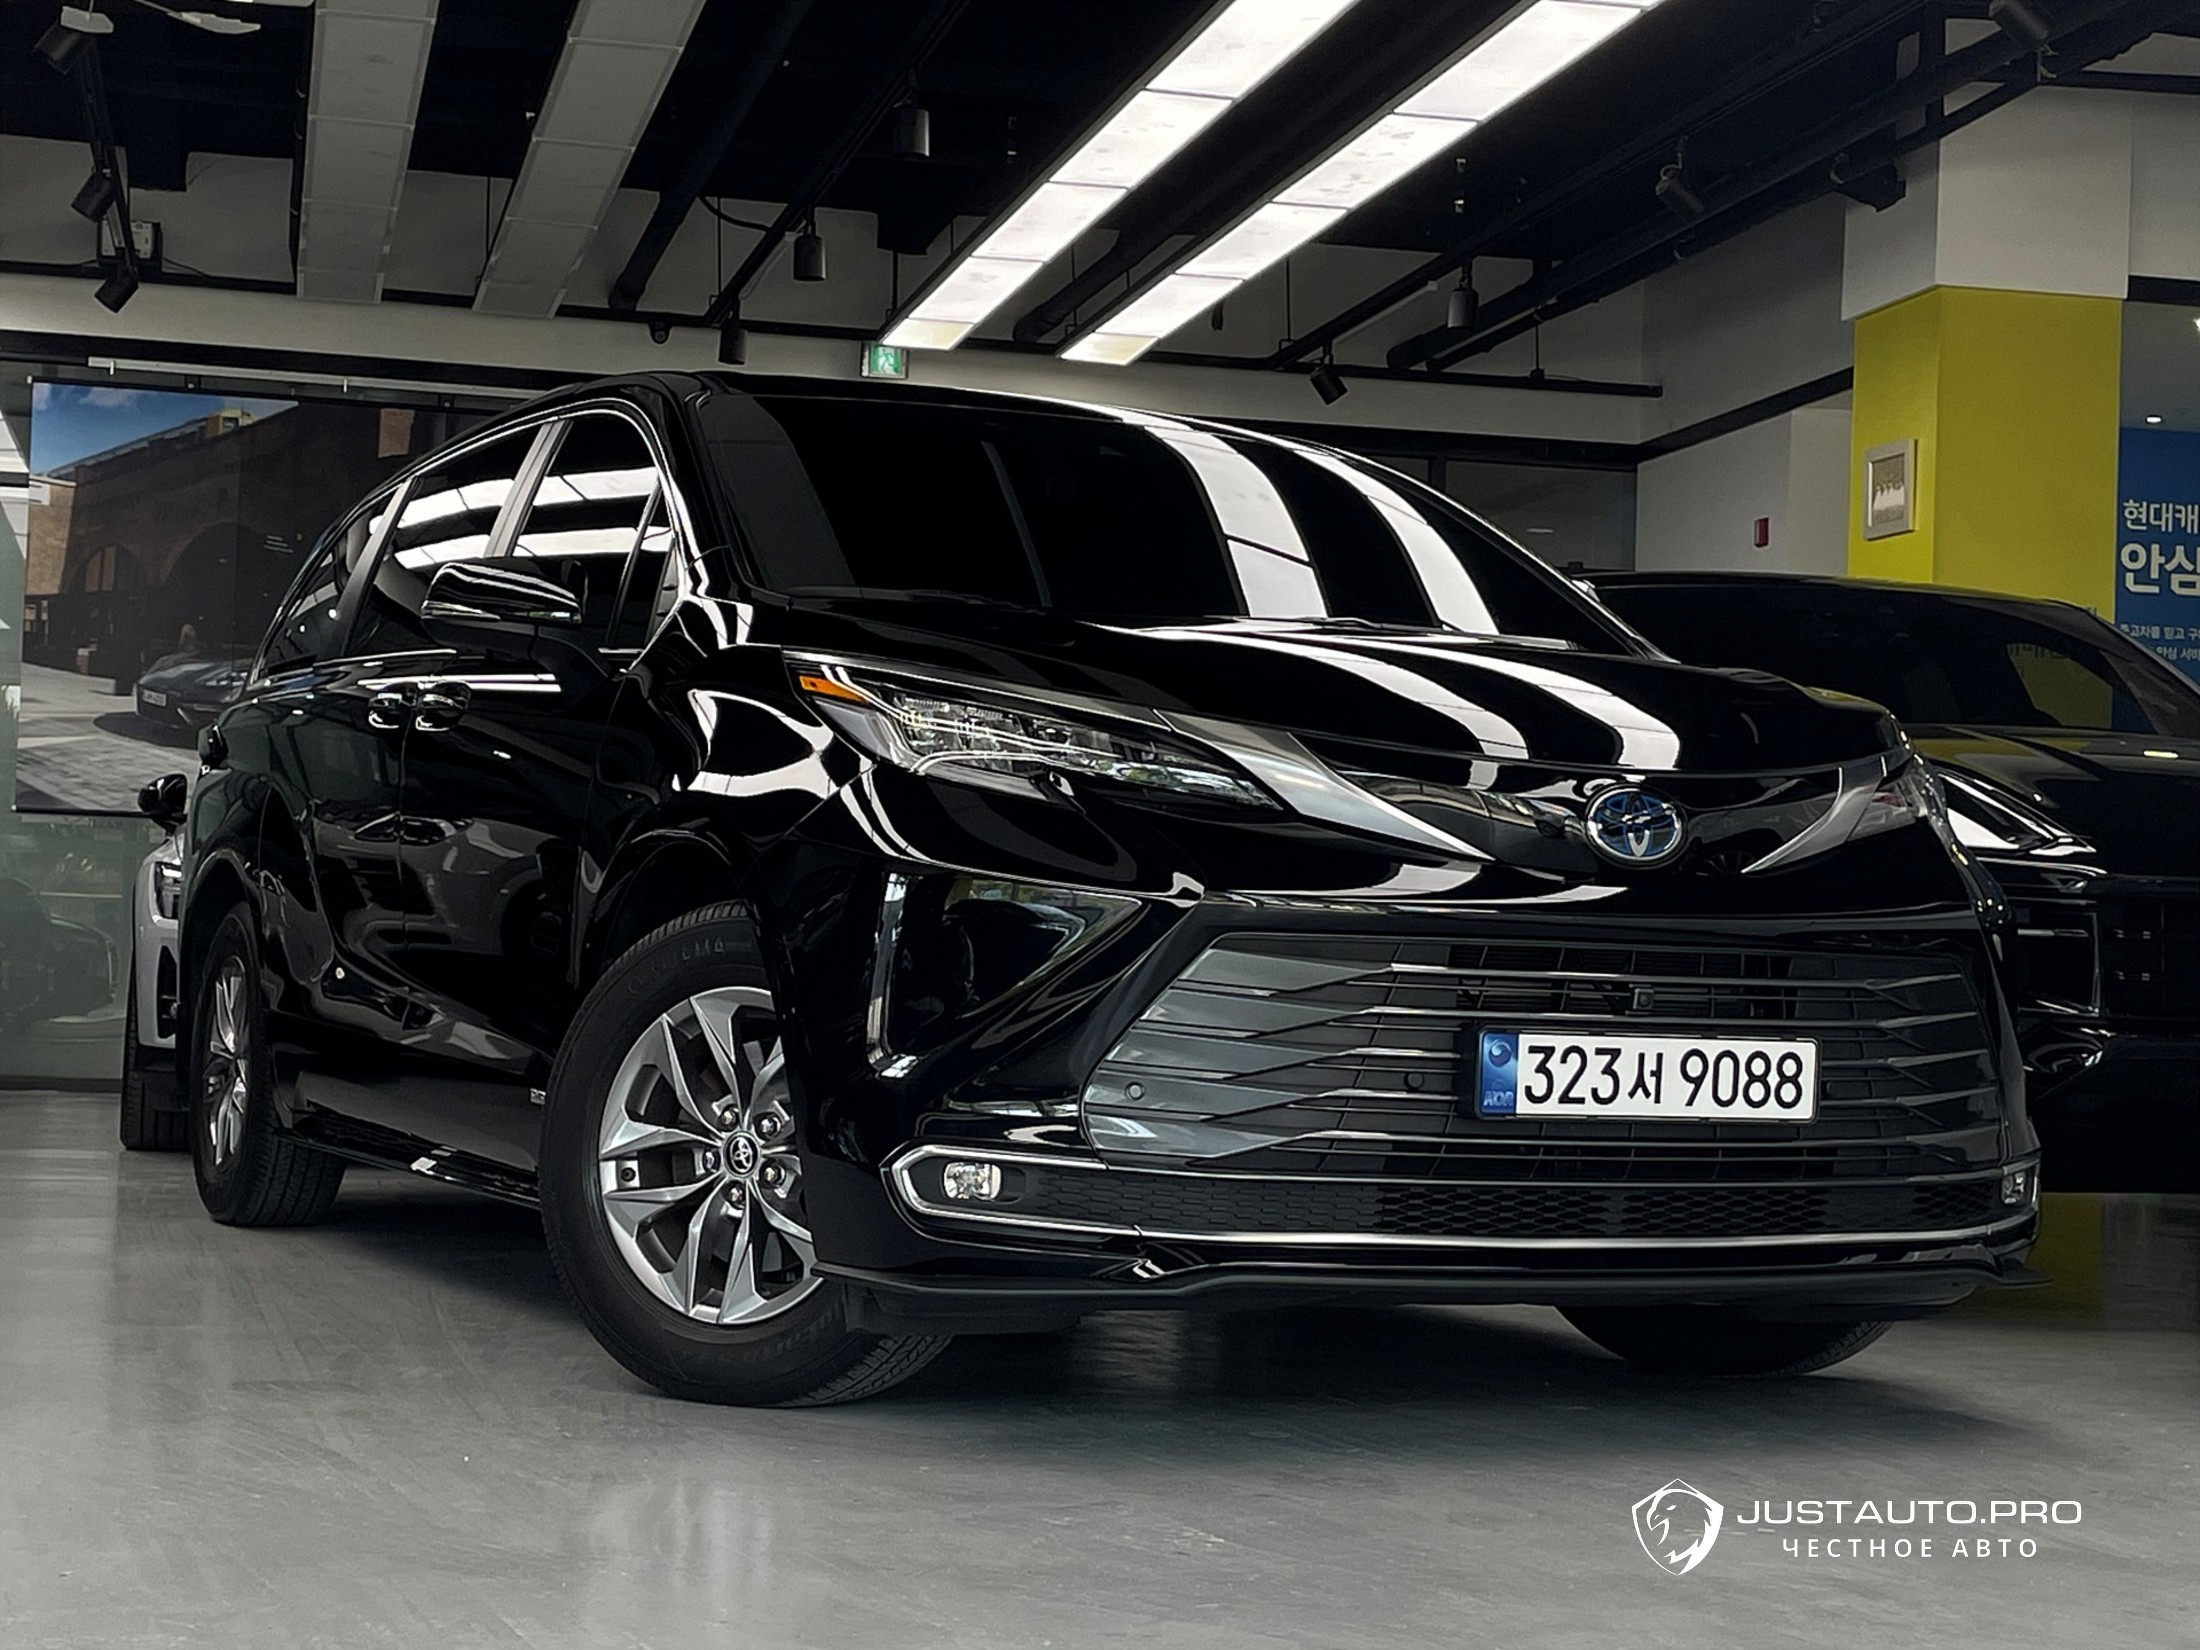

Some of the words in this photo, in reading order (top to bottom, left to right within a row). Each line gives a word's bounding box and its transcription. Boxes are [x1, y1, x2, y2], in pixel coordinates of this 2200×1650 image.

[2123, 499, 2199, 534] 현대캐
[2120, 542, 2200, 597] 안심
[1524, 1045, 1664, 1105] 323서
[1680, 1048, 1803, 1109] 9088
